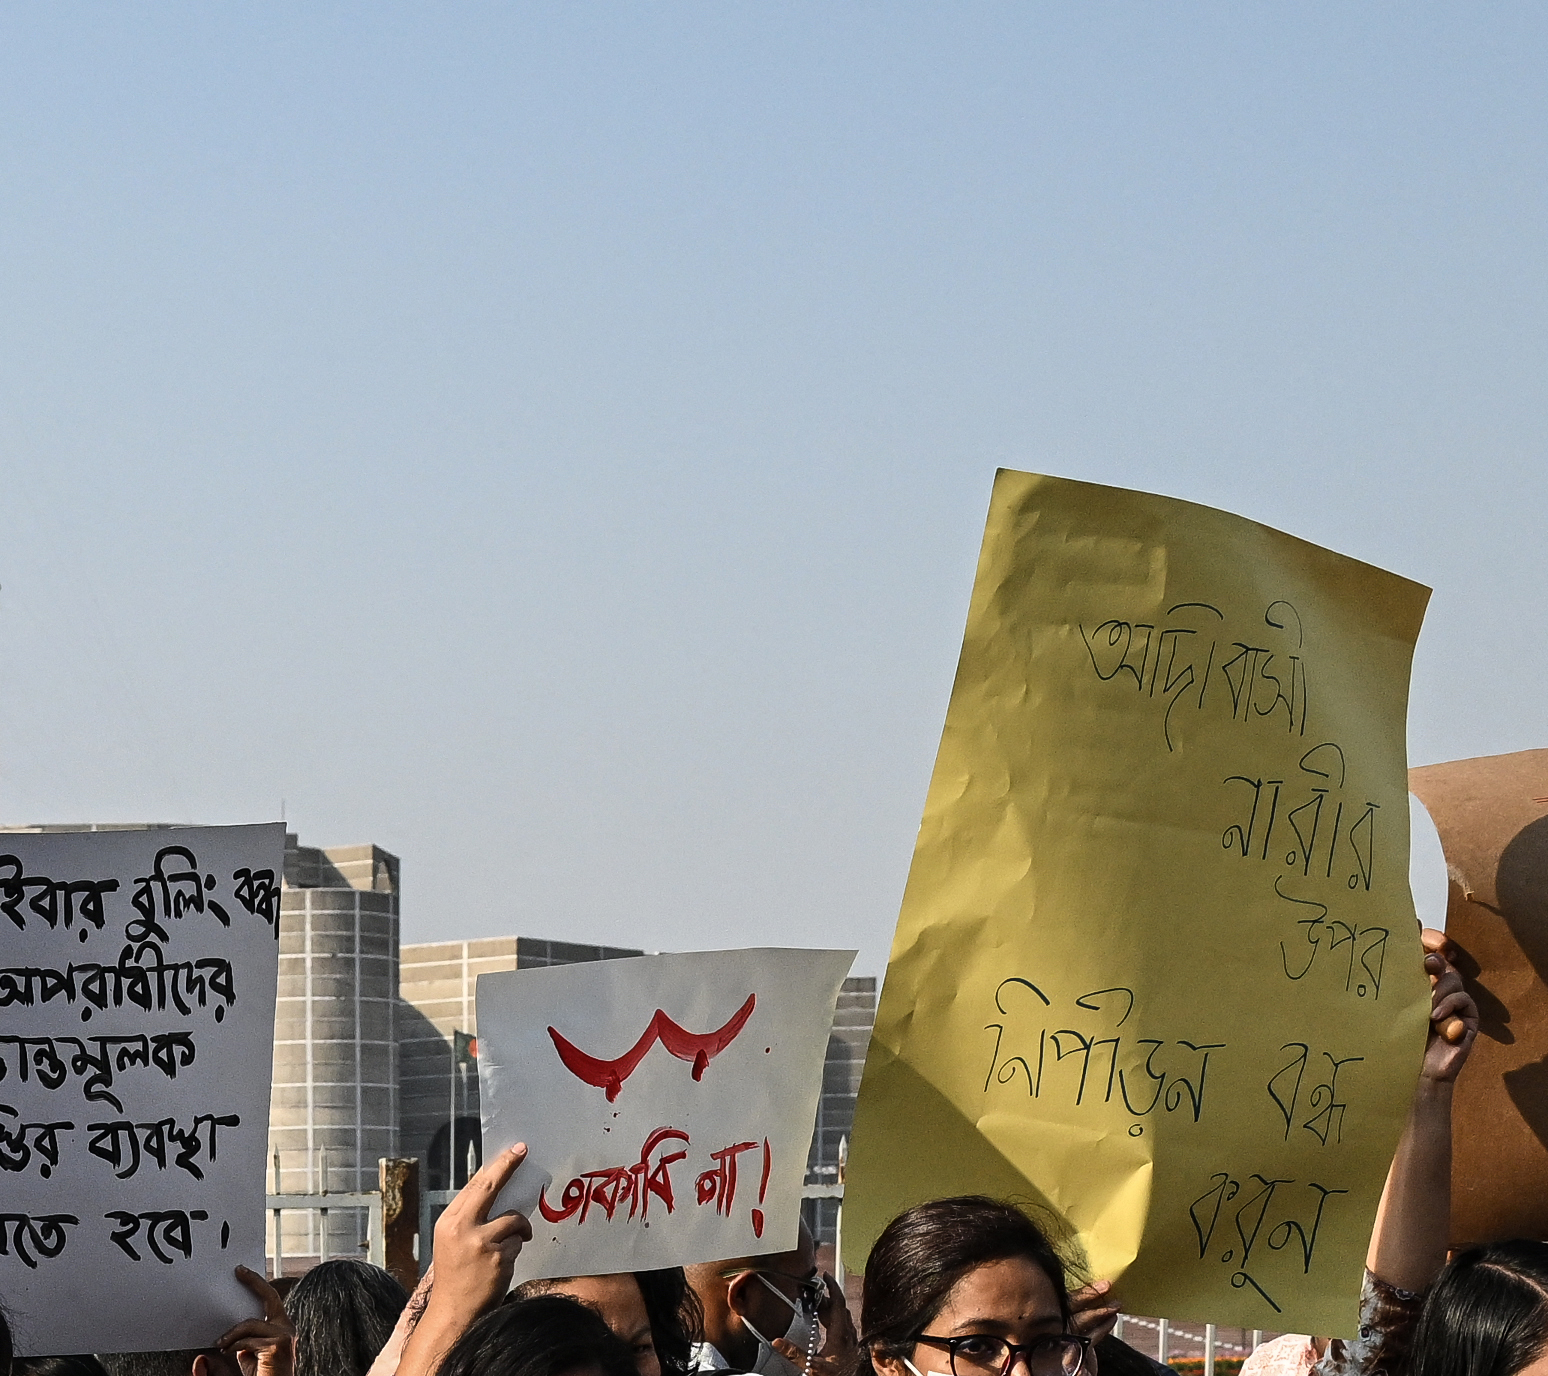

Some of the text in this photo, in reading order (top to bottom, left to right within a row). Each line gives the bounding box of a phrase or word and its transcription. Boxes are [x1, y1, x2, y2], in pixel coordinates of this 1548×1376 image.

[1079, 602, 1309, 752] আদিবাসী
[1222, 743, 1382, 892] নারীর
[125, 846, 230, 943] বুলিং
[233, 867, 280, 940] বন্ধ
[1275, 875, 1391, 1000] উপর
[984, 977, 1364, 1146] নিপীড়ন বন্ধ
[87, 1113, 241, 1181] ব্যবস্থা
[1188, 1173, 1349, 1312] করুন
